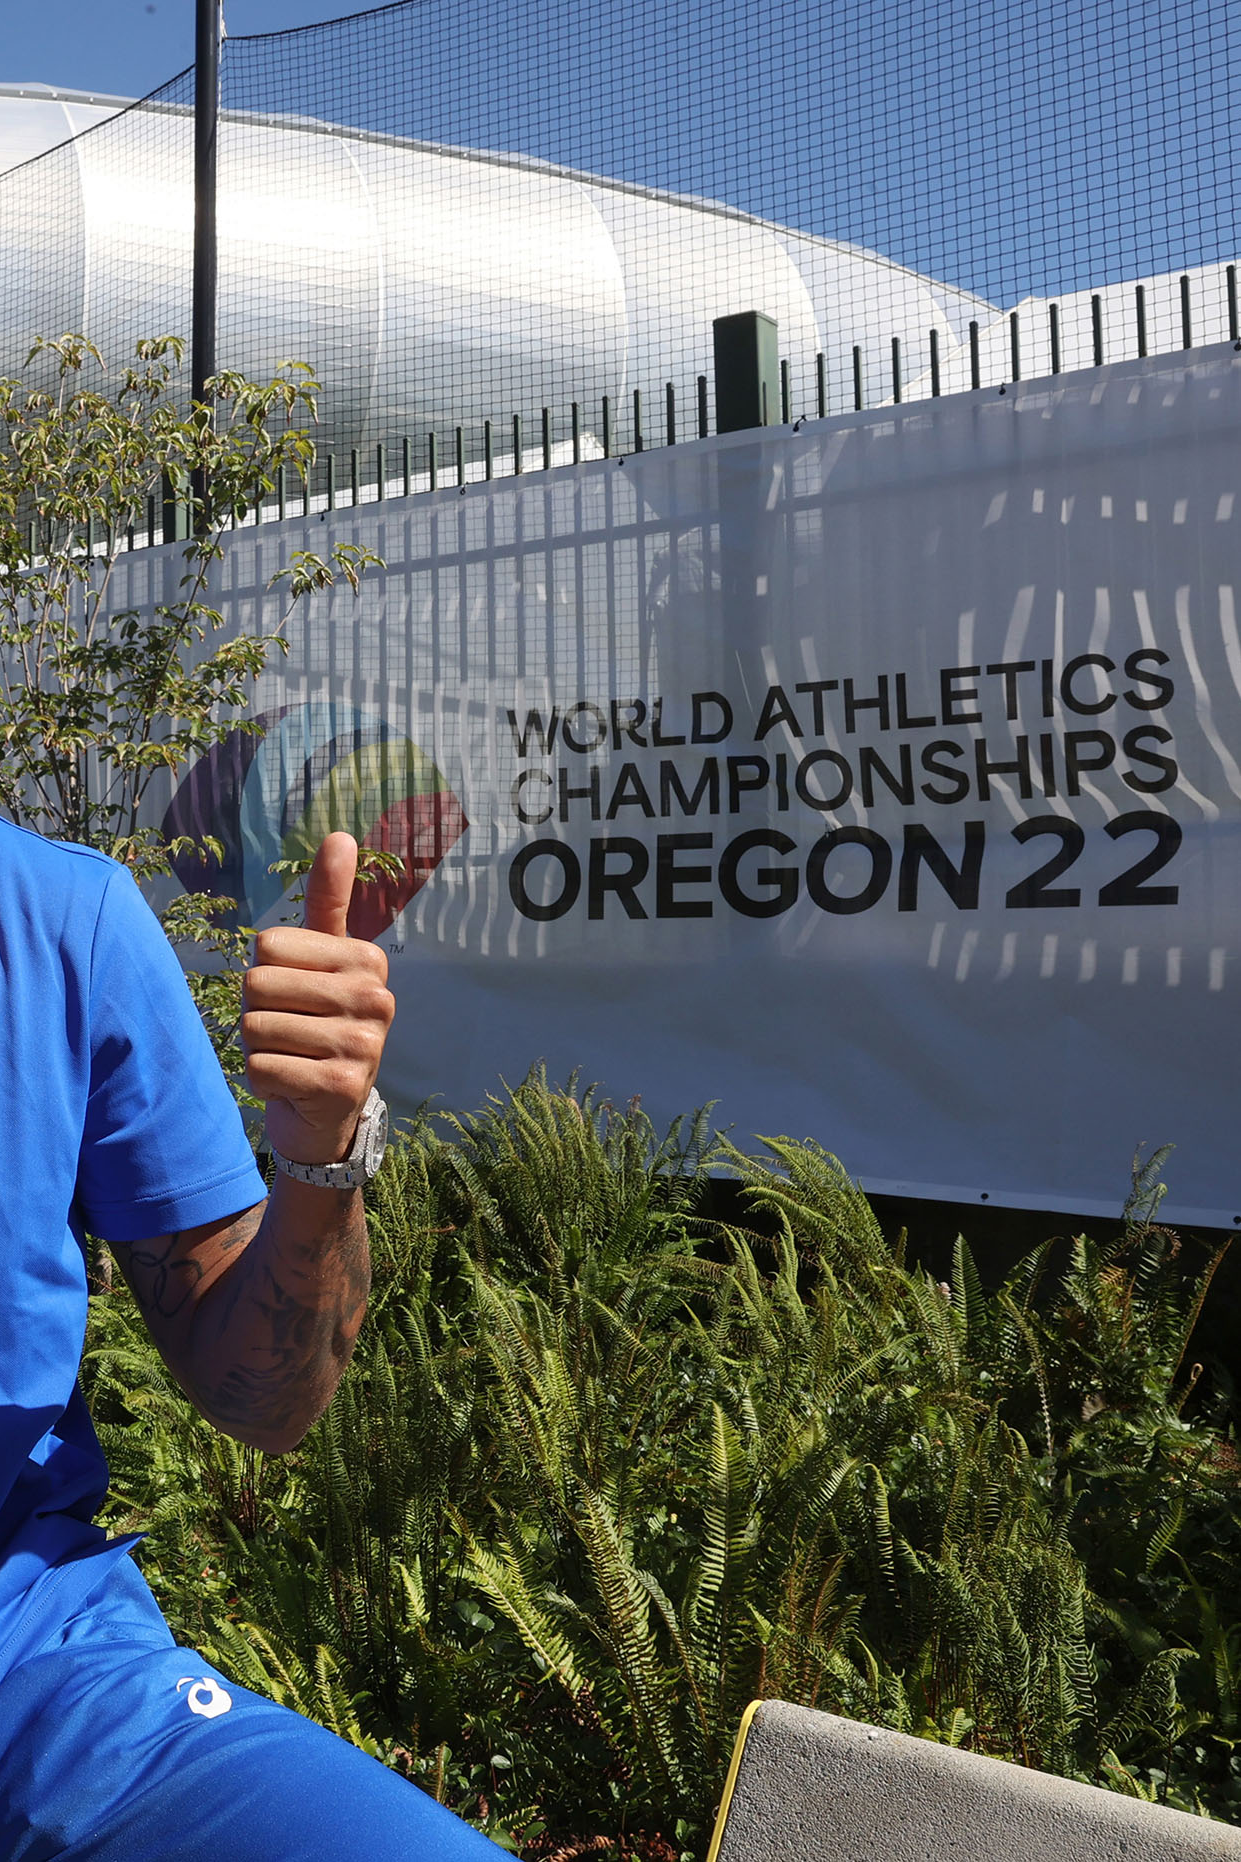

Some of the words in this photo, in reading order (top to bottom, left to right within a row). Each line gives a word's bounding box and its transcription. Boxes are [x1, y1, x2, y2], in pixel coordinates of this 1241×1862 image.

[507, 692, 733, 758] WORLD
[754, 648, 1174, 741] ATHLETICS
[511, 725, 1178, 825] CHAMPIONSHIPS
[508, 821, 986, 921] OREGON
[1005, 811, 1183, 908] 22
[389, 944, 405, 954] TM
